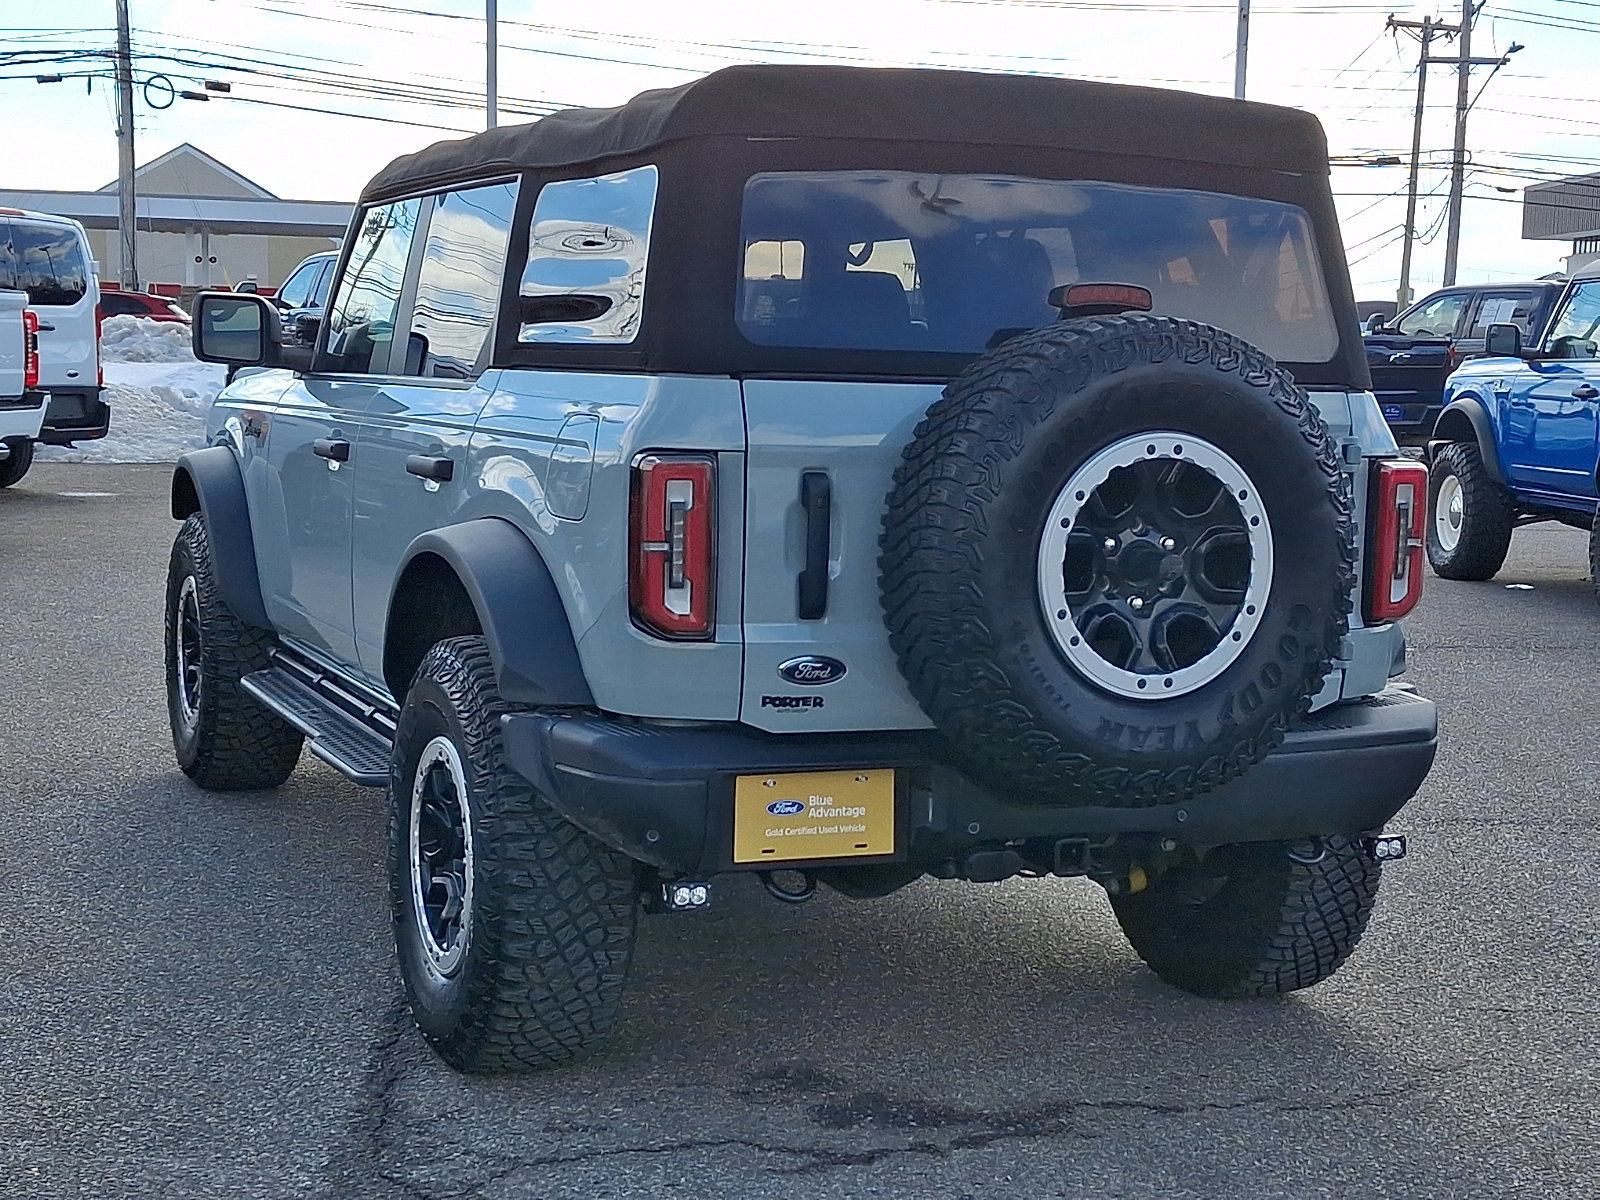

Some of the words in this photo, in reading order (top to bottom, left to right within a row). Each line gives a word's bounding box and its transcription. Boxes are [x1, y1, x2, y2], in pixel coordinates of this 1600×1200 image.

[795, 662, 831, 679] Ford
[761, 695, 824, 708] PORTER
[809, 795, 833, 806] Blue
[773, 801, 799, 814] Ford
[808, 806, 866, 818] Advantage
[765, 828, 783, 837] Gold
[785, 826, 817, 835] Certified
[818, 825, 838, 834] Used
[839, 823, 866, 833] Vehicle
